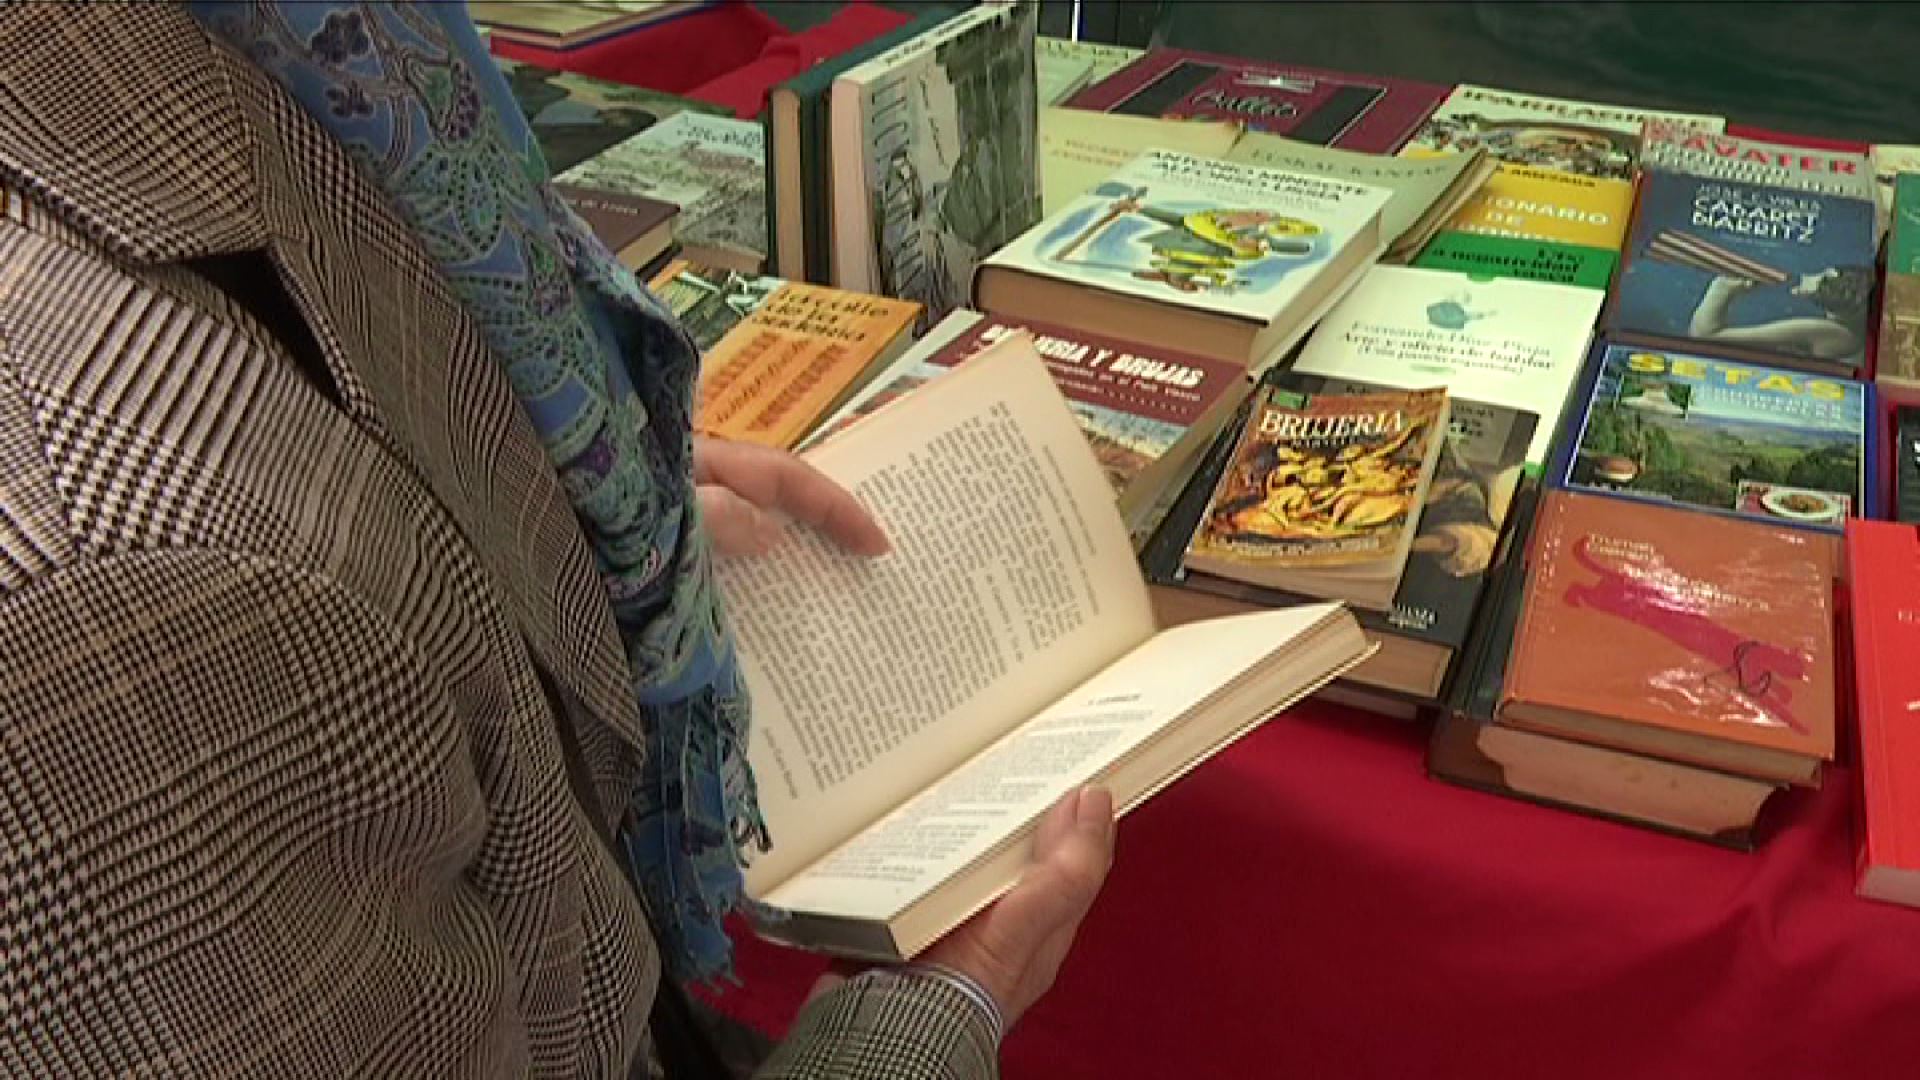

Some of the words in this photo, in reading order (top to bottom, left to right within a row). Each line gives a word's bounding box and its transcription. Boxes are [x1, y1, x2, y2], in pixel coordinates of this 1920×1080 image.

[1258, 169, 1369, 196] MINGOTE
[1485, 195, 1610, 227] IONARIO
[1090, 348, 1112, 367] Y
[1109, 353, 1204, 388] BRUJAS
[1627, 352, 1845, 400] SETAS
